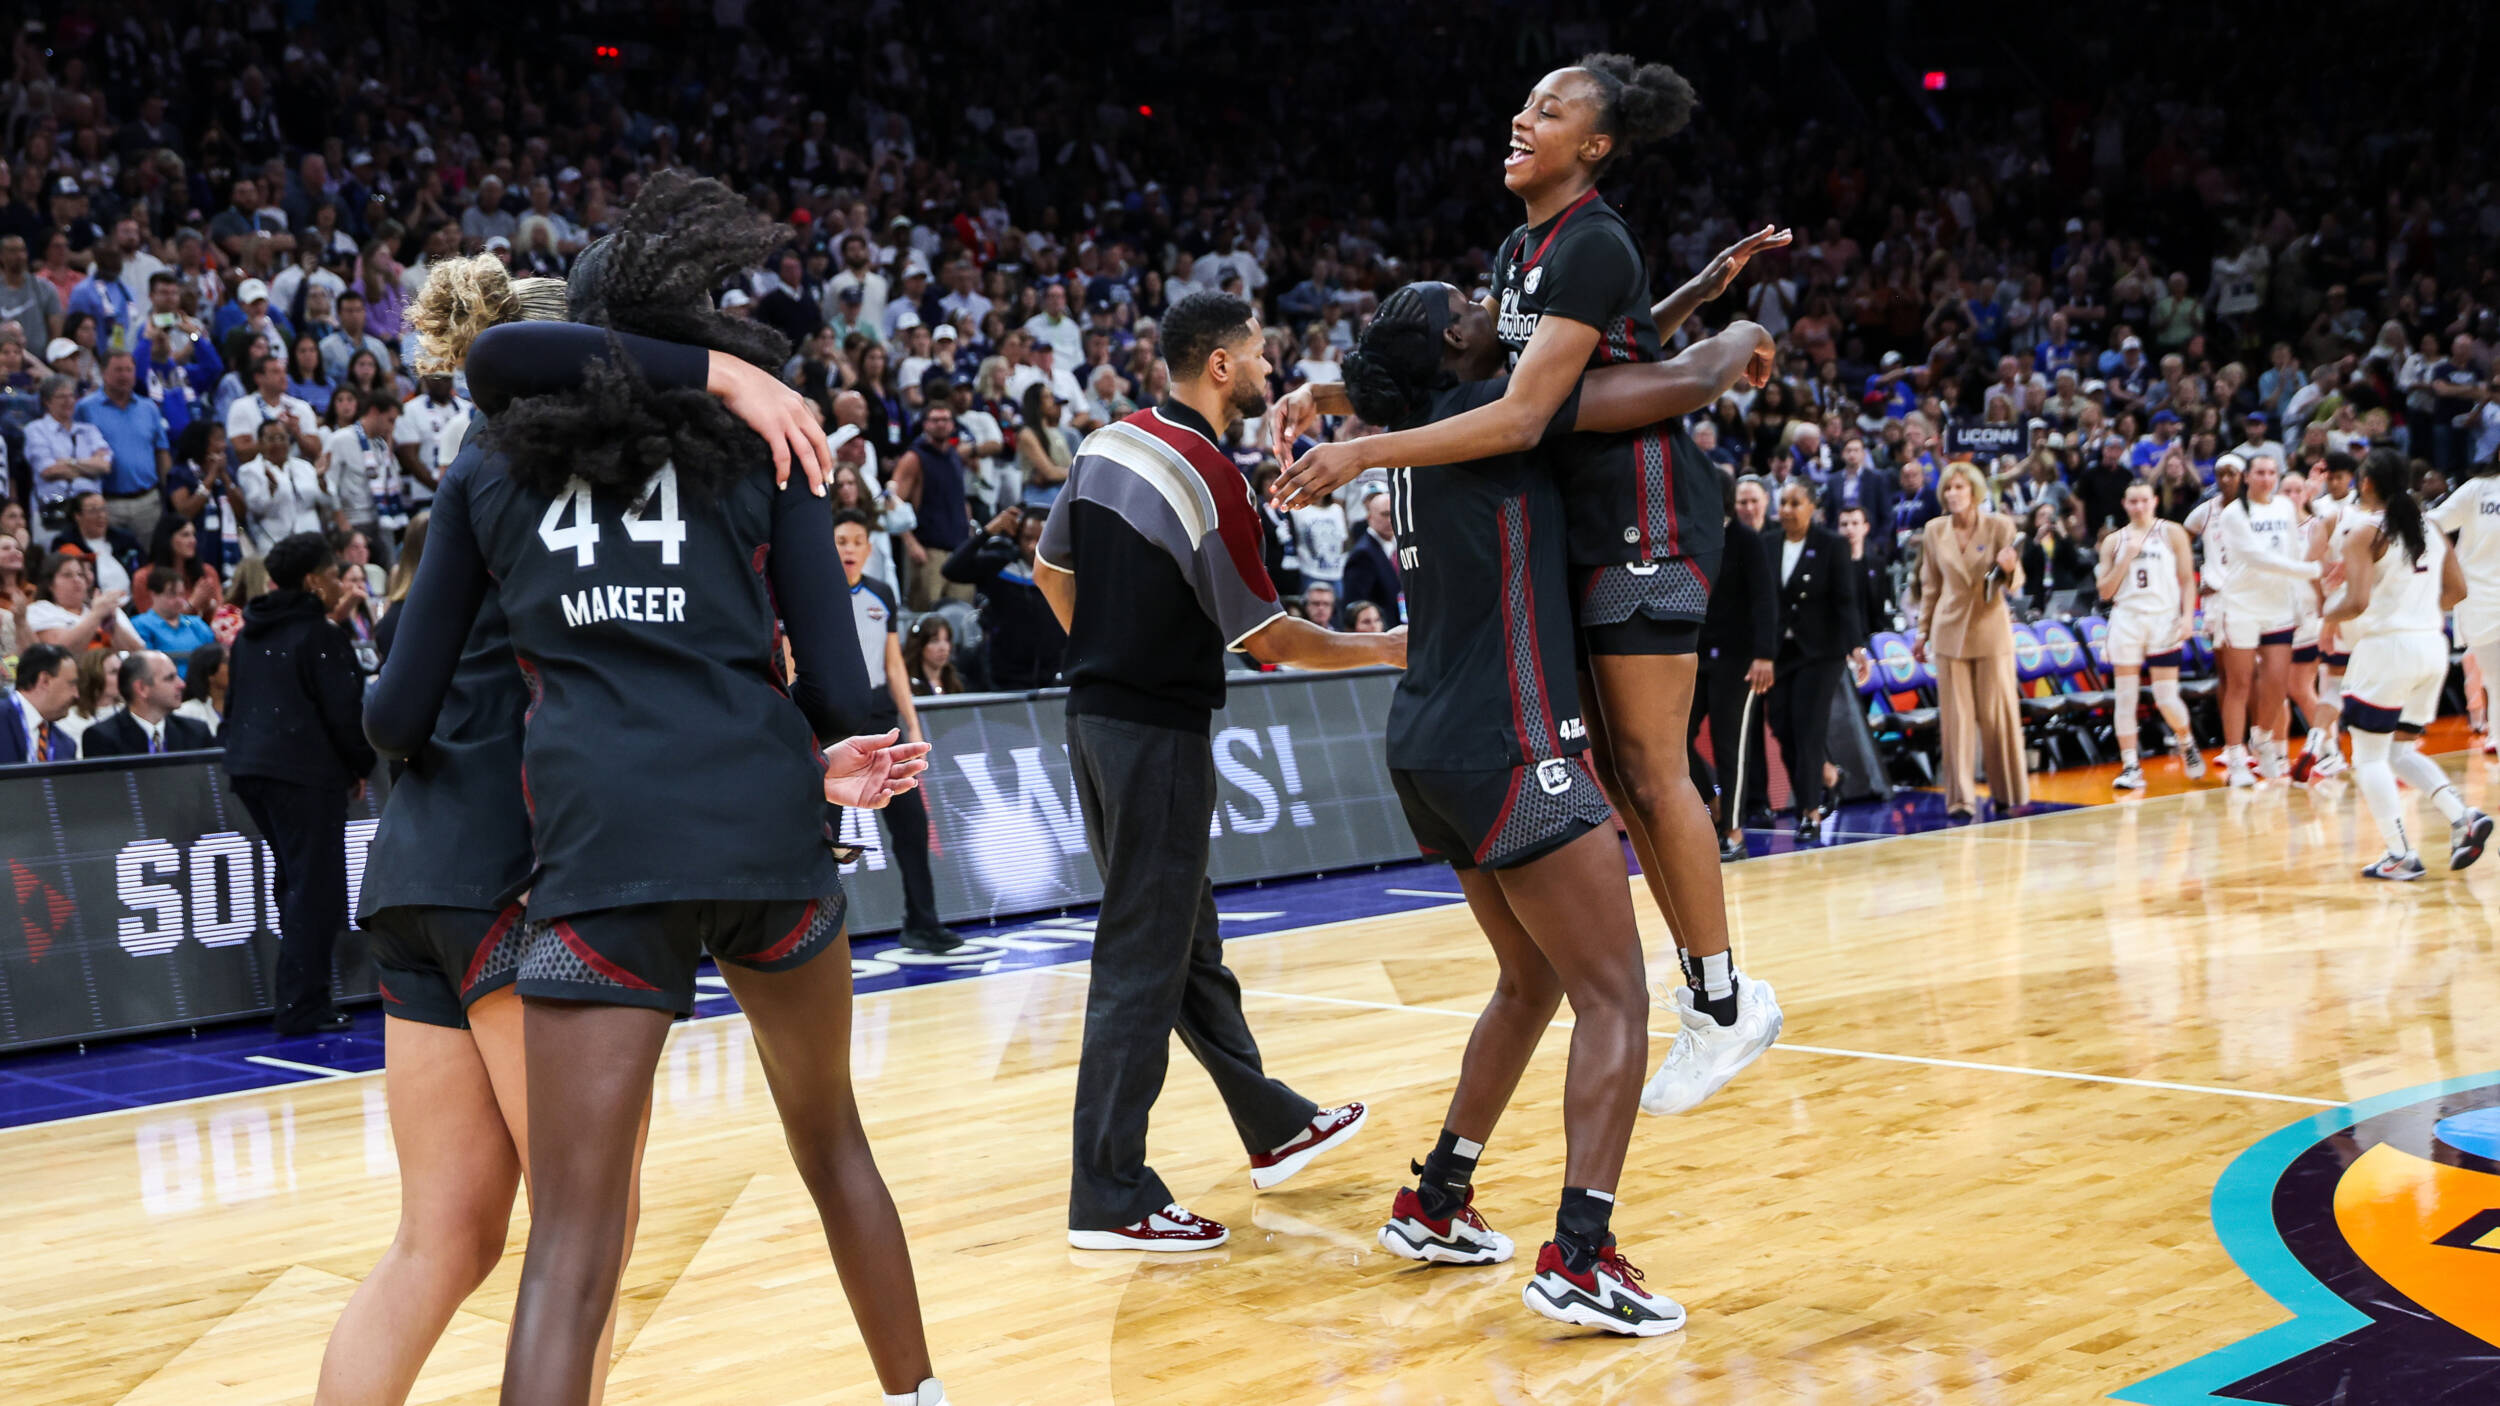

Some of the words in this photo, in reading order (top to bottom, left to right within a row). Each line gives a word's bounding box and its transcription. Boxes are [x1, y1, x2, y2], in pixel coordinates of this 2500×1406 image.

[1957, 428, 2020, 445] UCONN
[537, 458, 687, 568] 44
[1392, 465, 1415, 536] 11
[2136, 568, 2149, 589] 9
[561, 584, 687, 627] MAKEER
